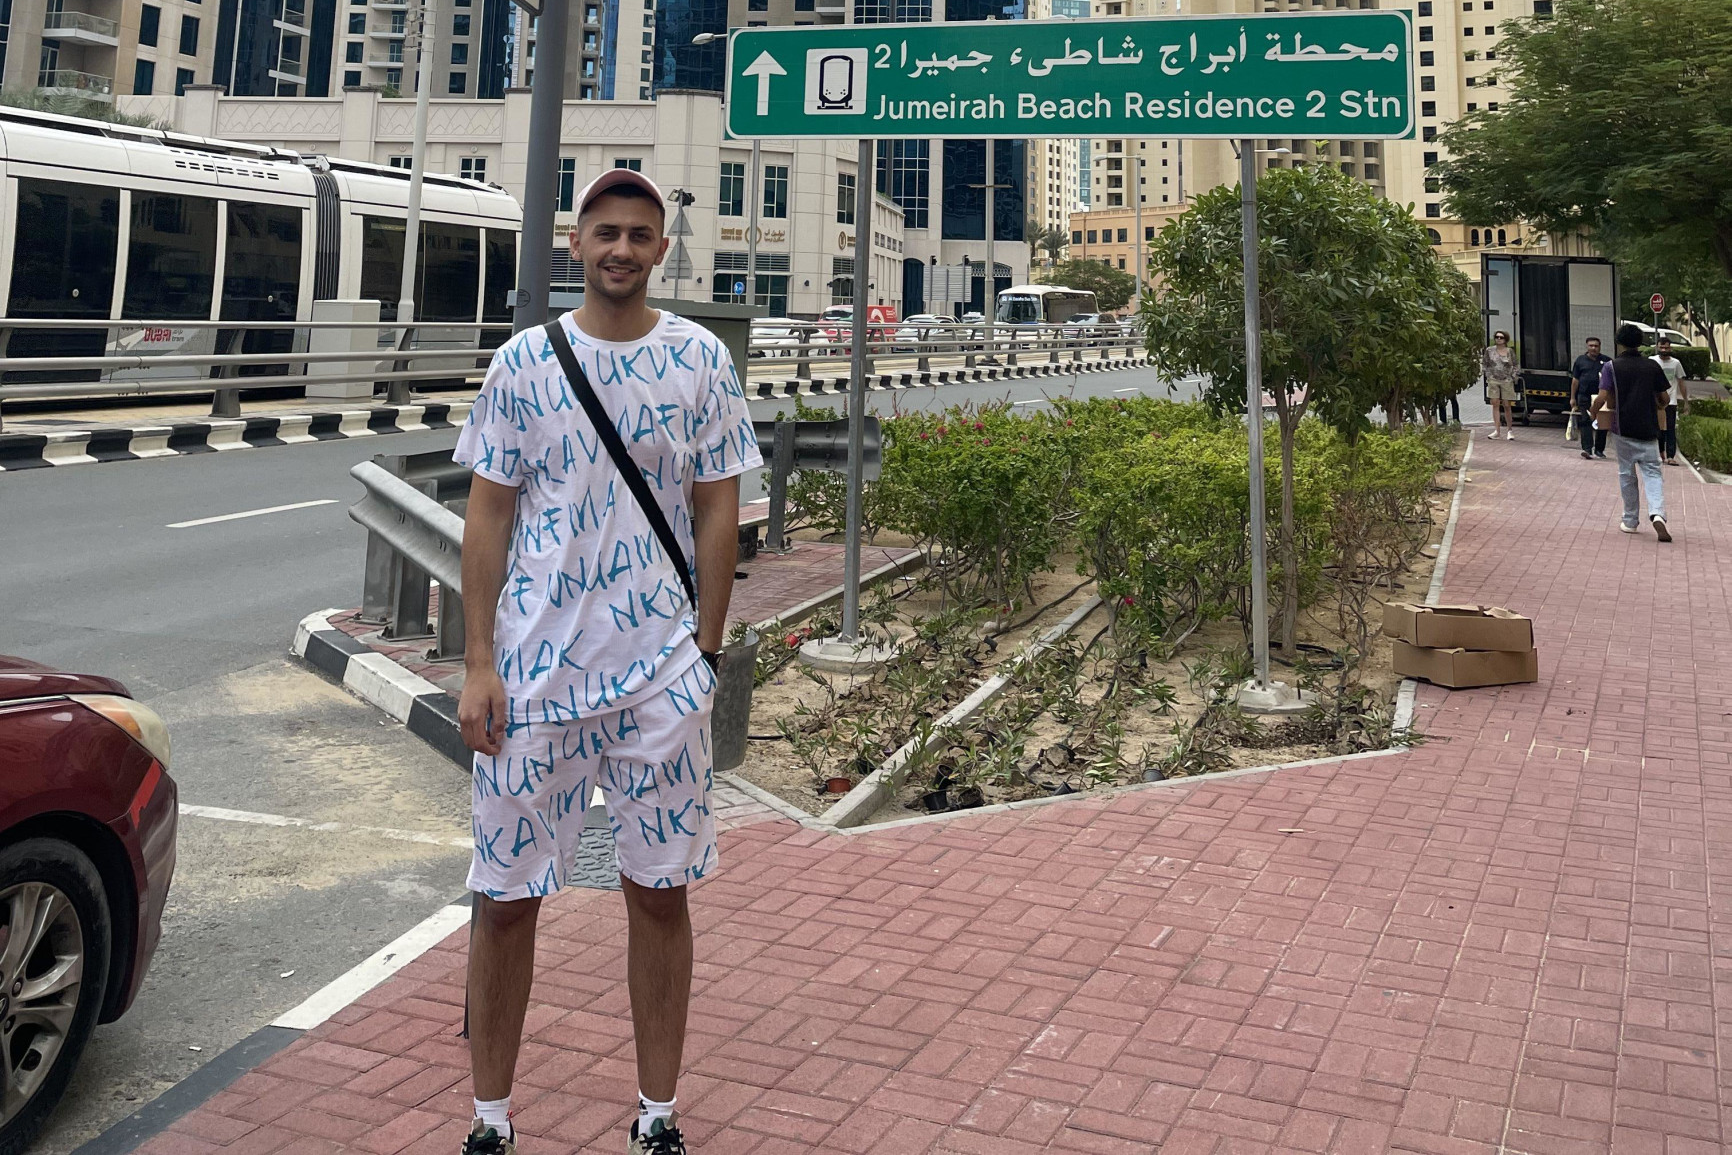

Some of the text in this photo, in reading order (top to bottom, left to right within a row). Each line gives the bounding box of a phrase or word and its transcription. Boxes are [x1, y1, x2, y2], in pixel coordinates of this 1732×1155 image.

[1158, 25, 1247, 76] أبراج
[1263, 31, 1400, 63] محطة
[872, 89, 1401, 120] Jumeirah Beach Residence 2 Stn
